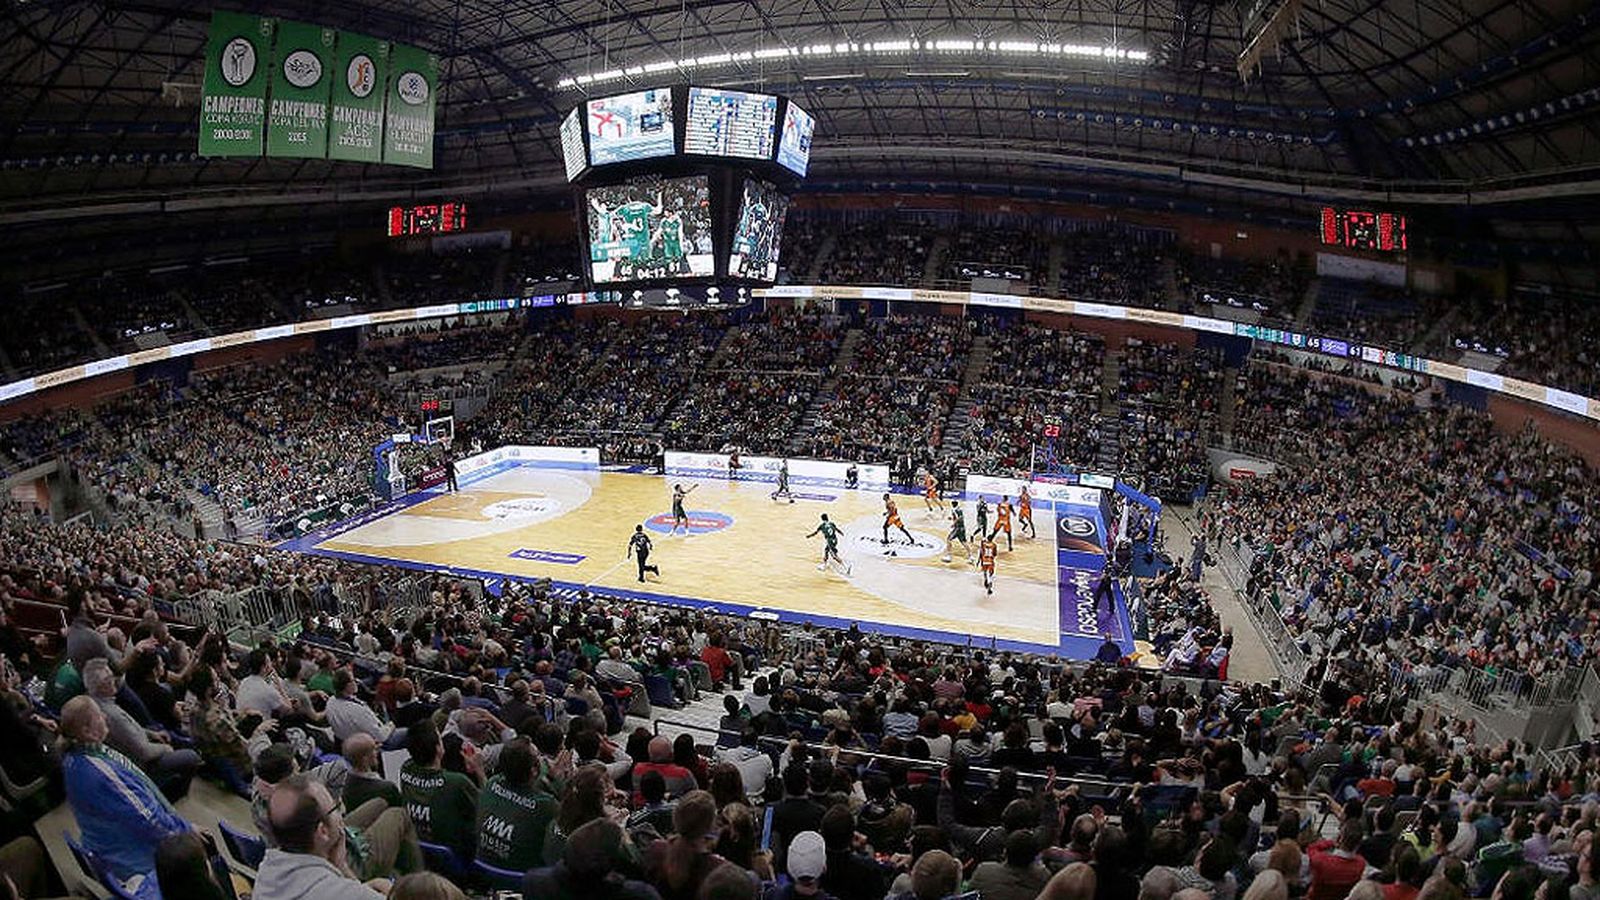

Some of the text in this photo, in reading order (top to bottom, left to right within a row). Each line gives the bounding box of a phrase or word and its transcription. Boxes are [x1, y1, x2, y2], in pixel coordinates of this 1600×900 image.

[204, 95, 265, 115] CAMPEONES
[271, 99, 326, 119] CAMPEONES
[205, 113, 231, 124] COPA
[637, 267, 667, 281] 04:12
[1307, 338, 1320, 348] 65
[1044, 424, 1060, 437] 23
[400, 772, 445, 788] VOLUNTARIO
[490, 781, 538, 811] VOLUNTARIO
